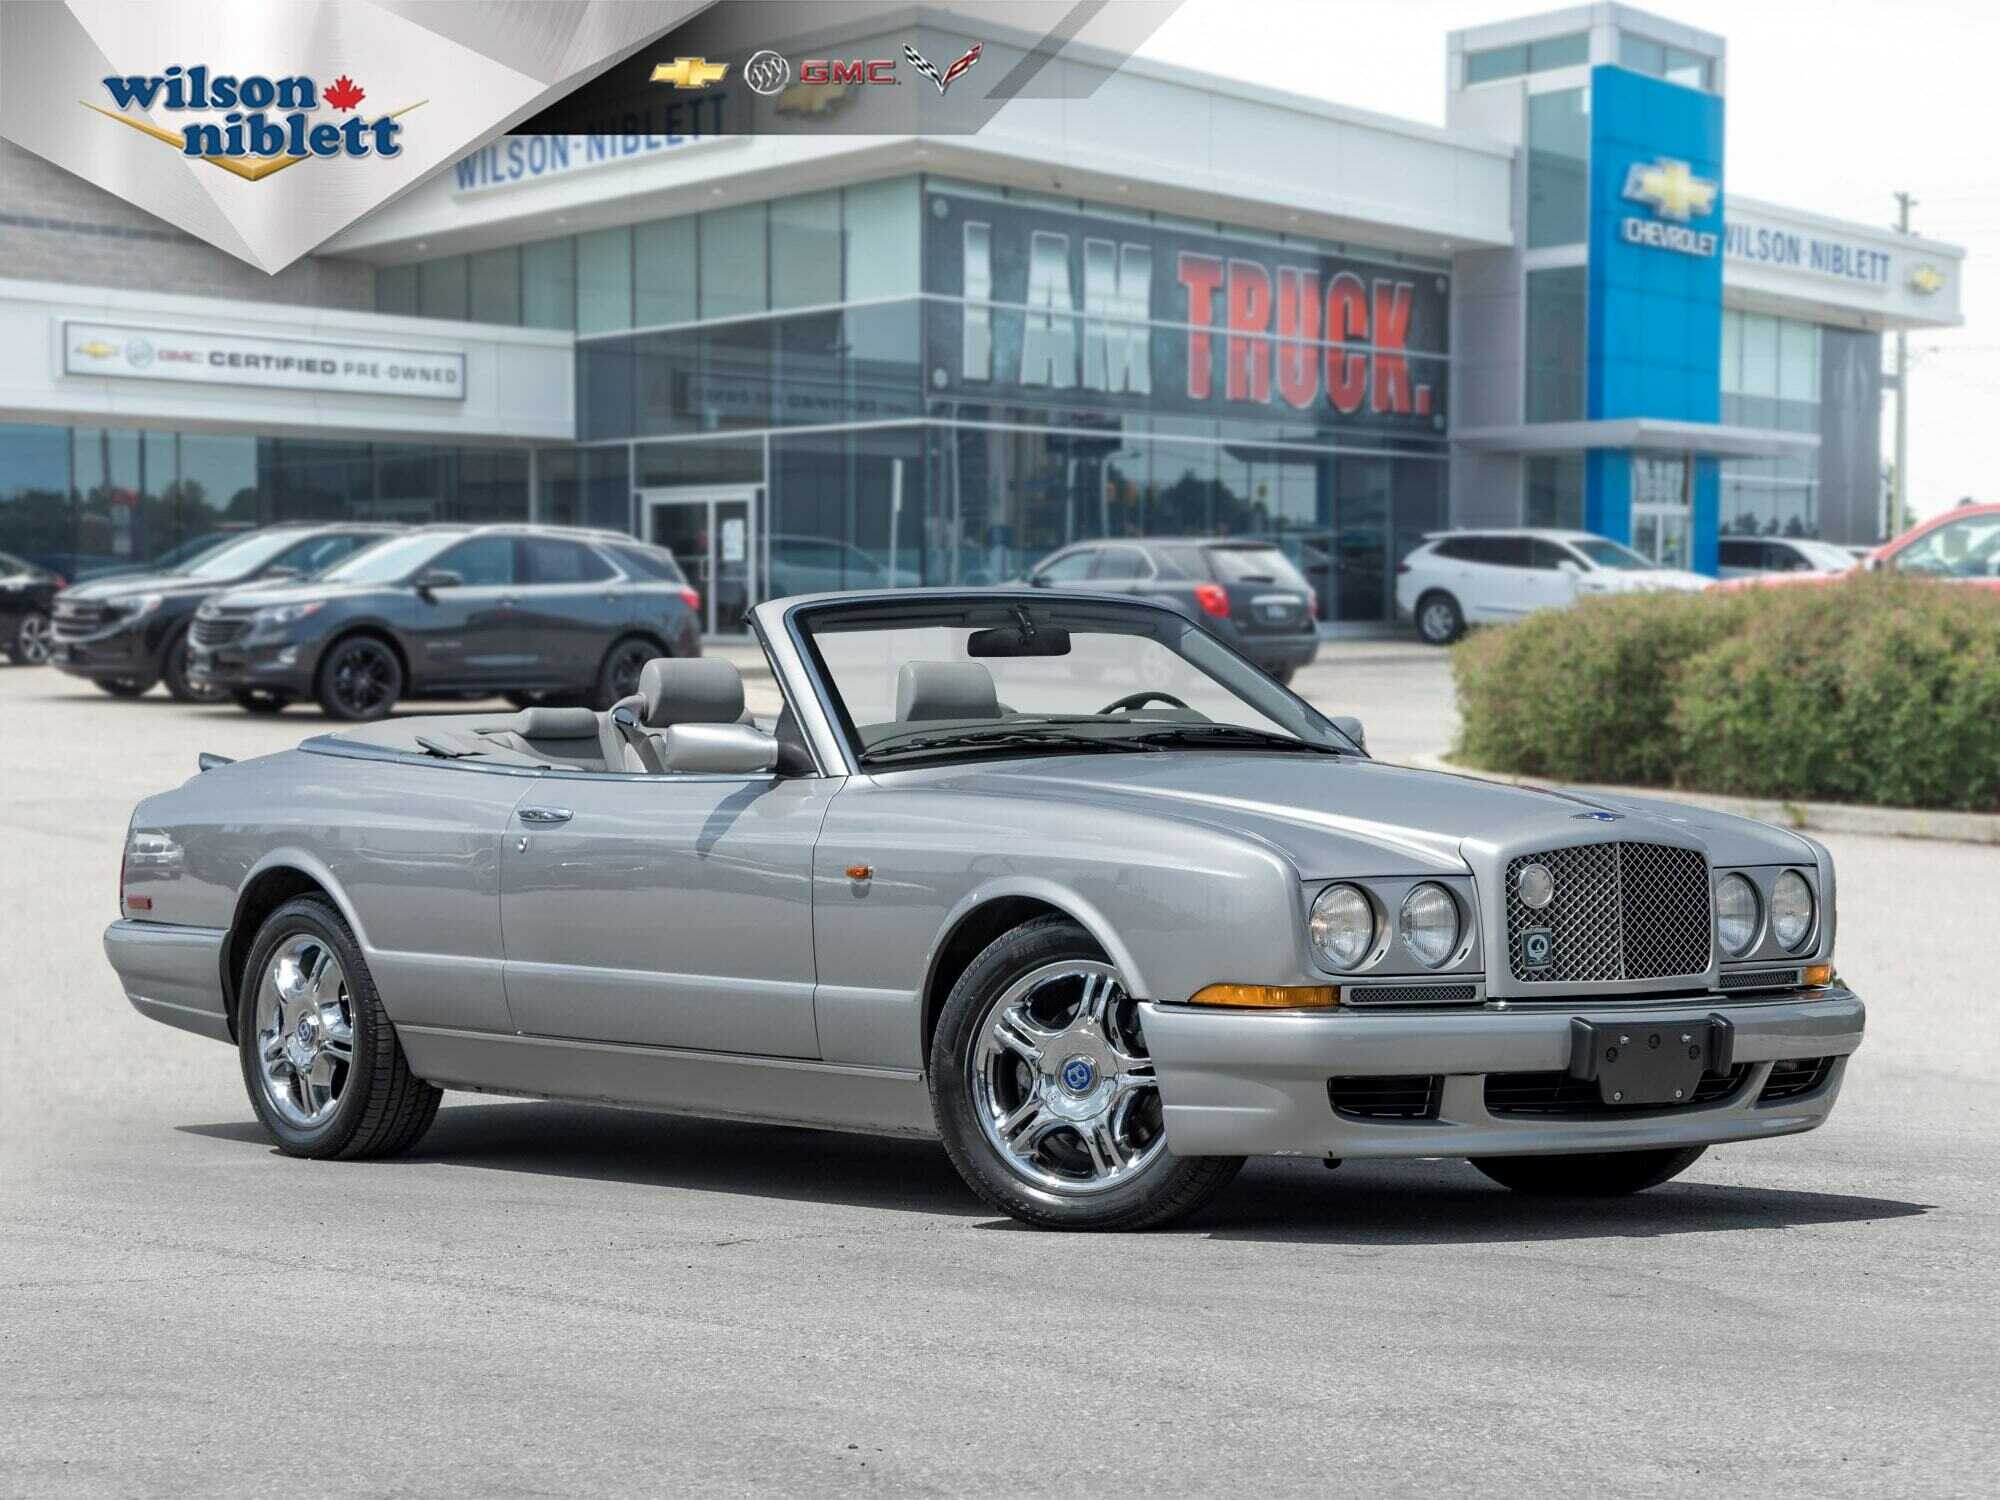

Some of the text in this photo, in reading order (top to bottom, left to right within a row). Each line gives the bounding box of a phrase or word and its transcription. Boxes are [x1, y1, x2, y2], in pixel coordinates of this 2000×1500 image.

[1622, 217, 1718, 257] CHEVROLET
[1809, 239, 1890, 283] NIBLETT
[962, 220, 1431, 416] I AM TRUCK.
[208, 350, 338, 376] CERTIFIED
[343, 362, 457, 384] PRE-OWNED
